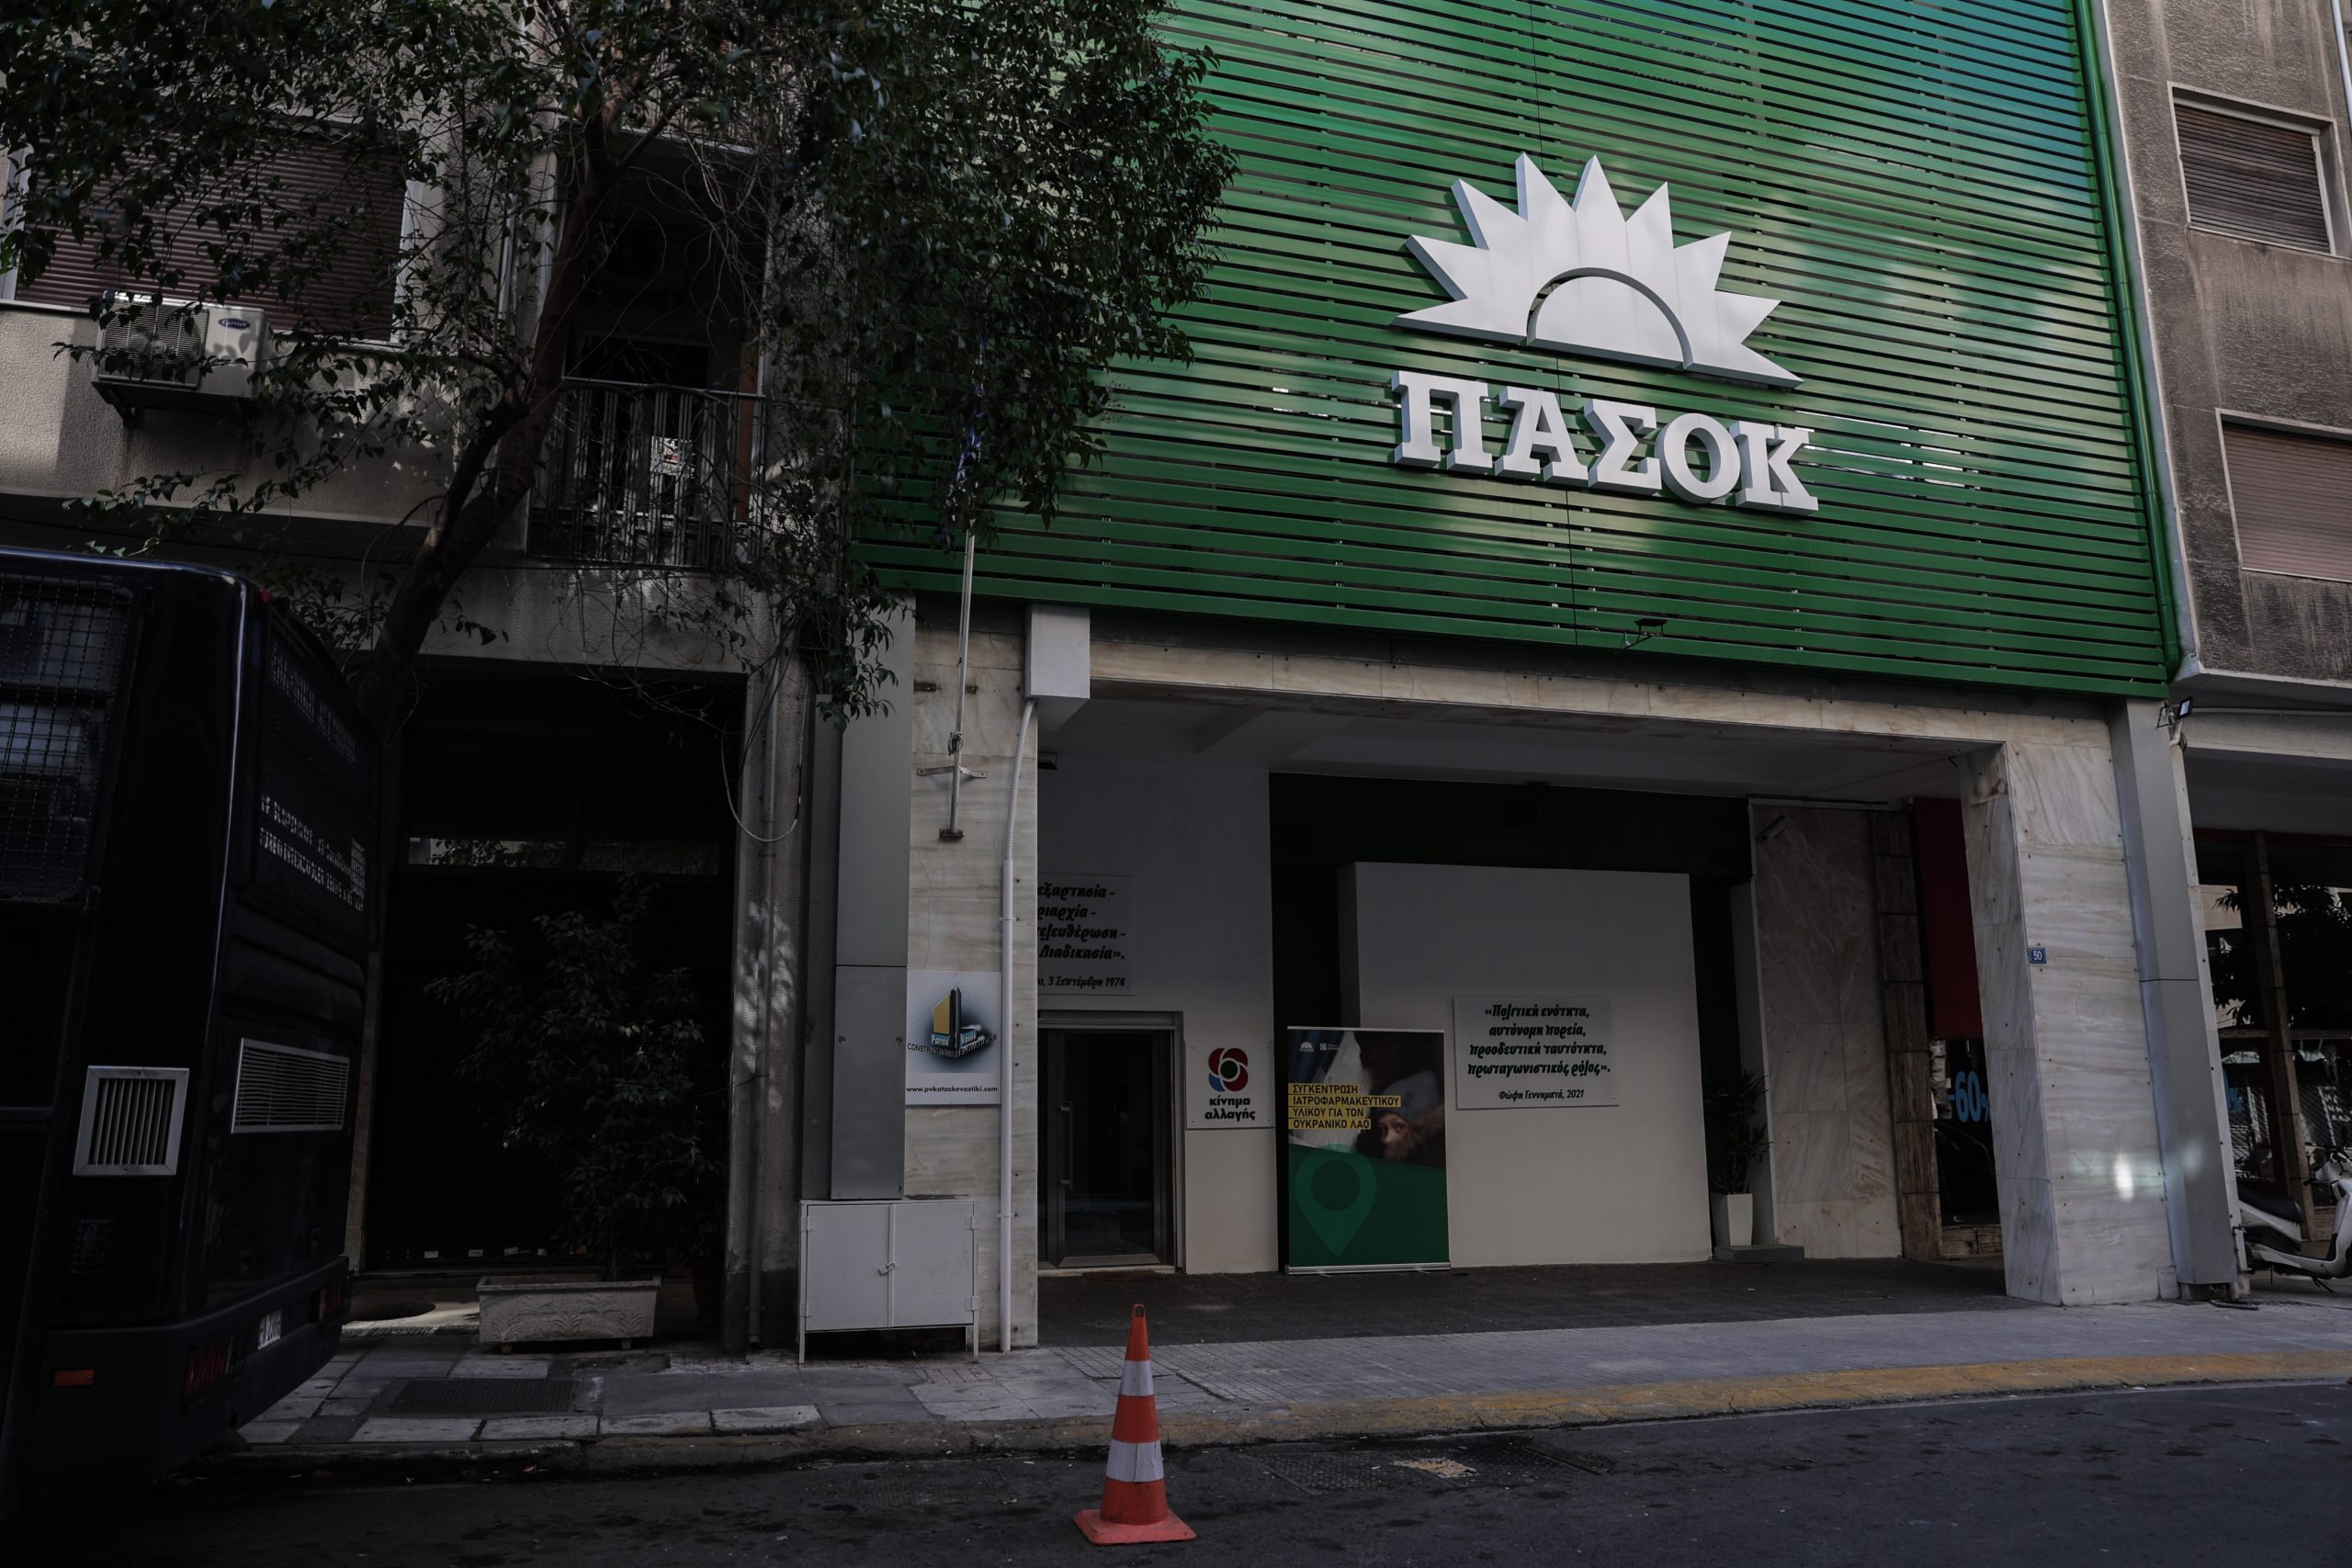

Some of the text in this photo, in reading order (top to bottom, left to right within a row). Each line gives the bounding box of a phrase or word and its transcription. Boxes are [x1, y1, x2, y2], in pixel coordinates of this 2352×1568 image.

[1391, 369, 1819, 515] ΠΑΣΟΚ
[1037, 923, 1118, 942] ελευθέρωση
[2033, 950, 2042, 961] 50
[1047, 976, 1054, 986] 3
[1105, 976, 1125, 987] 1974
[1485, 1004, 1589, 1021] «Πολιτική ενότητα,
[1489, 1022, 1587, 1039] αυτόνομη πορεία,
[931, 1034, 950, 1045] Panos
[1469, 1042, 1607, 1059] προοδευτική ταυτότητα,
[1467, 1060, 1569, 1078] πρωταγωνιστικός
[1293, 1084, 1358, 1094] ΣΥΓΚΕΝΤΡΩΣΗ
[1498, 1089, 1585, 1101] Φώφη Γεννηματά, 2021
[1209, 1094, 1250, 1109] κίνημα
[1293, 1096, 1399, 1106] ΙΑΤΡΟΦΑΡΜΑΚΕΥΤΙΚΟΥ
[1204, 1108, 1256, 1122] αλλαγής
[1293, 1108, 1364, 1117] ΥΛΙΚΟΥ ΓΙΑ ΤΟΝ
[1293, 1119, 1370, 1129] ΟΥΚΡΑΝΙΚΟ ΛΑΟ
